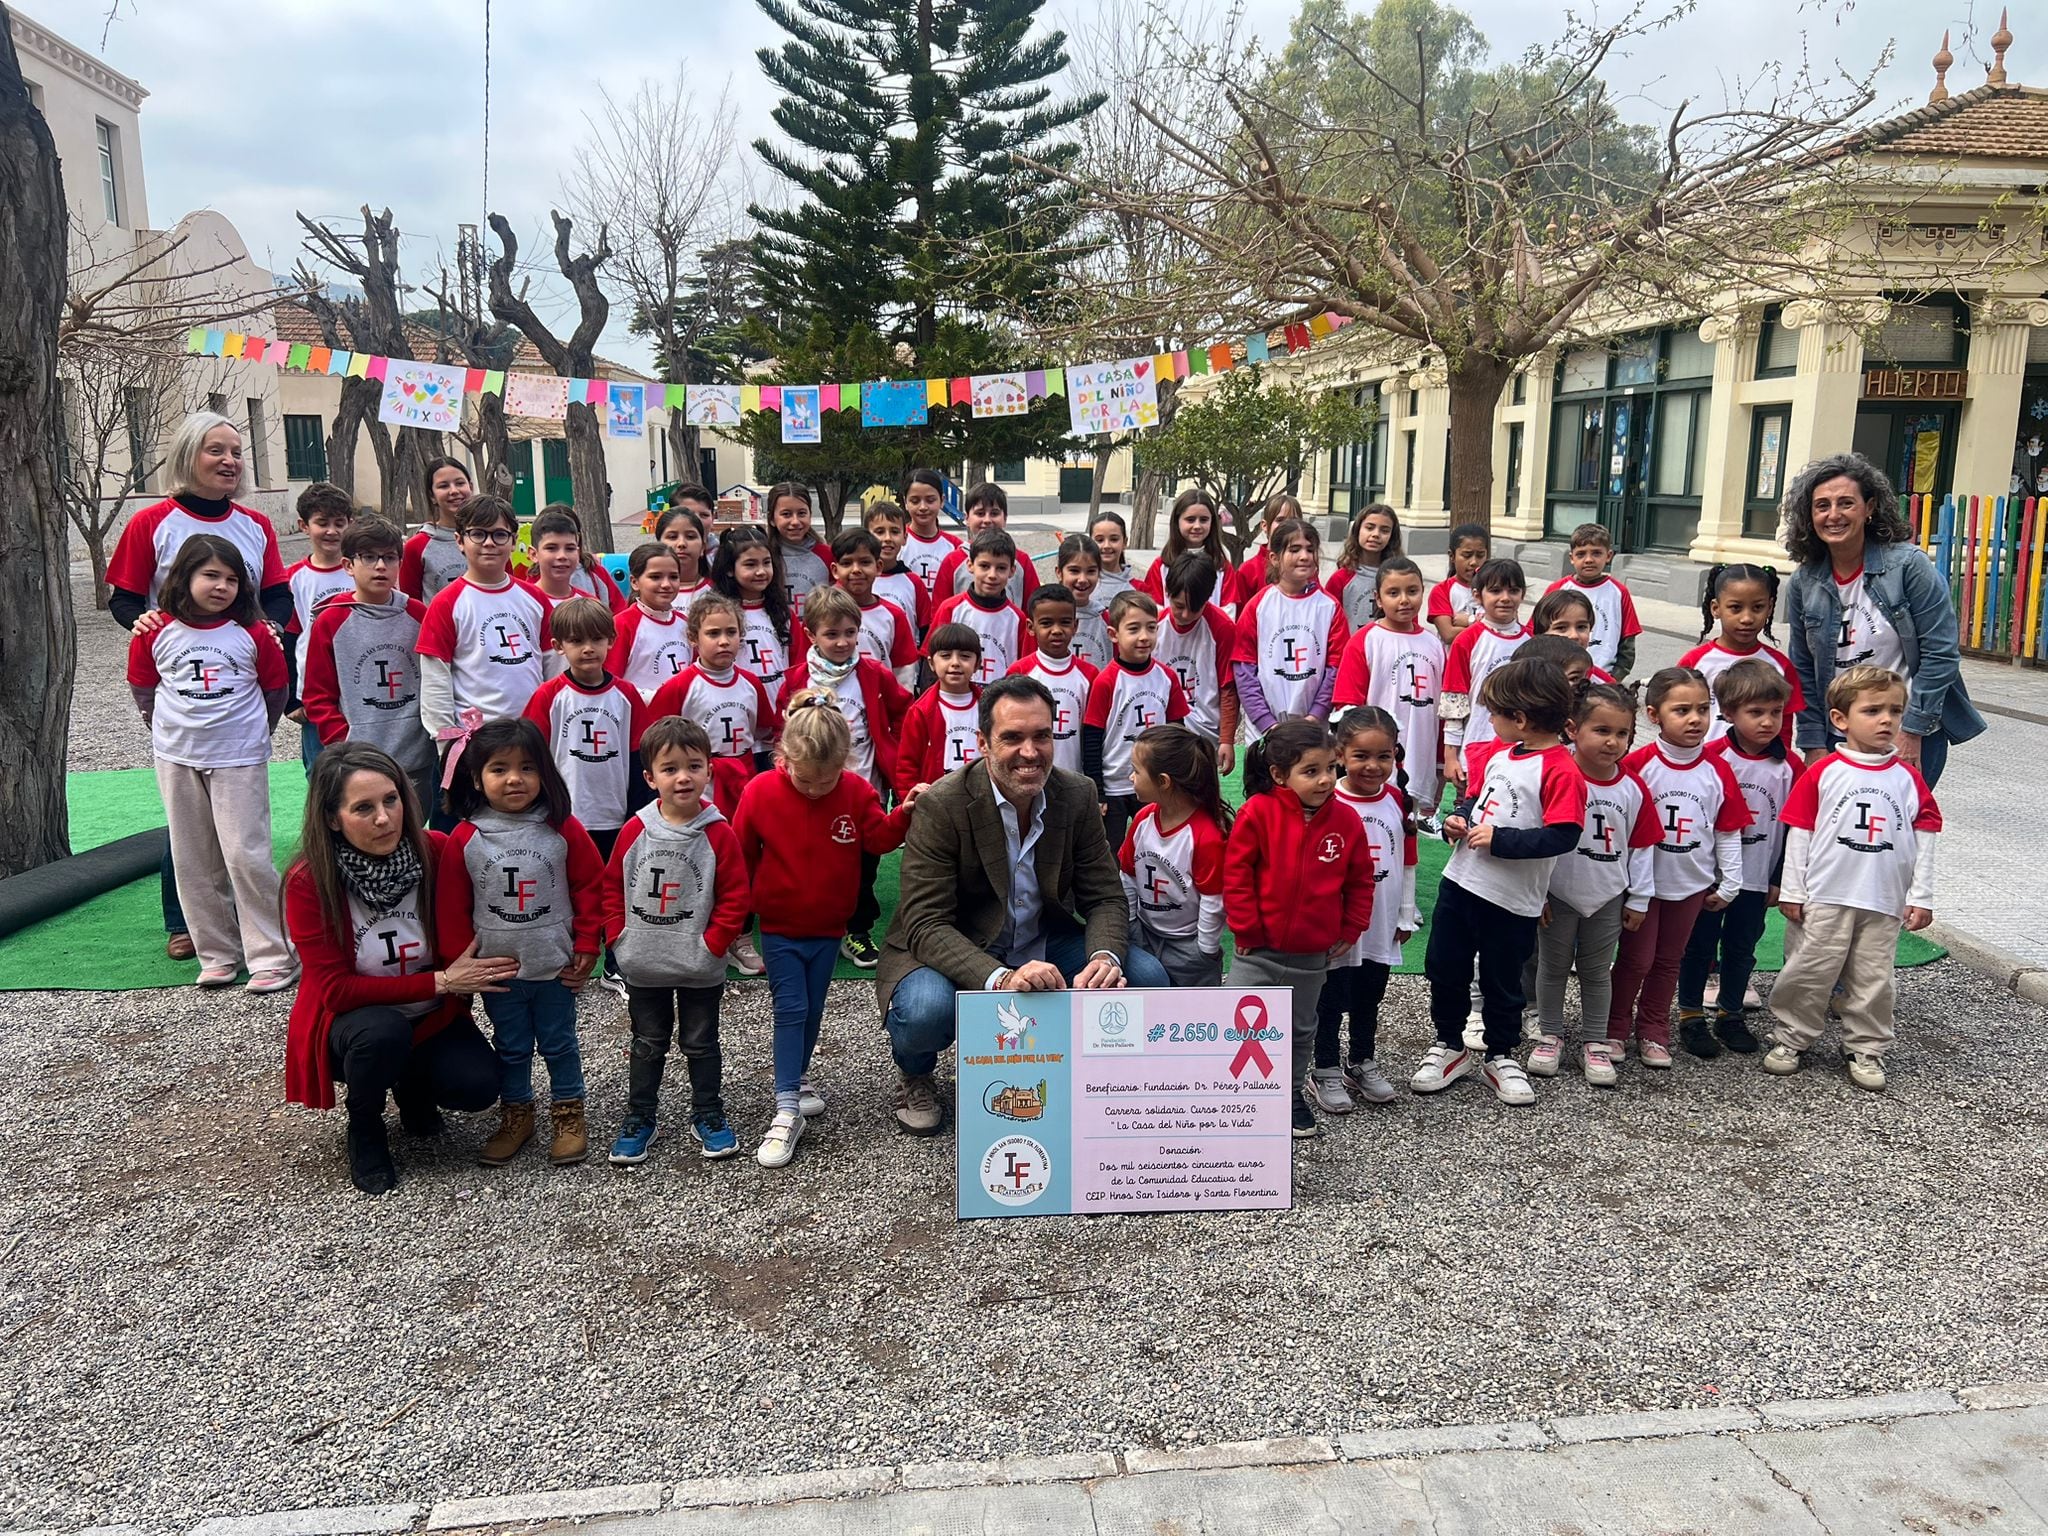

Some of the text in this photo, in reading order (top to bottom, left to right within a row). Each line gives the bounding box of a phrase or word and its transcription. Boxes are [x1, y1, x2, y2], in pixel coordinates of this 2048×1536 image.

[405, 371, 432, 381] CASA
[1076, 368, 1134, 387] LA CASA
[1866, 369, 1961, 397] HUERTO
[1078, 390, 1104, 404] DEL
[1081, 399, 1140, 421] POR LA
[1090, 414, 1135, 432] VIDA
[1169, 1023, 1219, 1042] 2.650
[1224, 1025, 1284, 1042] euros
[1143, 1081, 1190, 1091] Fundación
[1213, 1081, 1241, 1094] Pérez
[1243, 1080, 1281, 1090] Pallarés
[1104, 1106, 1142, 1116] Carrera
[1190, 1104, 1219, 1114] Curso
[1131, 1121, 1154, 1130] Casa
[1158, 1119, 1173, 1129] del
[1175, 1119, 1196, 1129] Niño
[1199, 1120, 1216, 1131] por
[1219, 1118, 1229, 1128] la
[1231, 1118, 1255, 1128] Vida"
[1099, 1160, 1265, 1171] Dos mil seiscientos cincuenta euros
[1111, 1173, 1254, 1186] de la Comunidad Educativa del
[1136, 1190, 1154, 1199] San
[1157, 1189, 1191, 1199] Isidoro
[1194, 1191, 1201, 1201] y
[1204, 1188, 1231, 1198] Santa
[1234, 1187, 1279, 1197] Florentina
